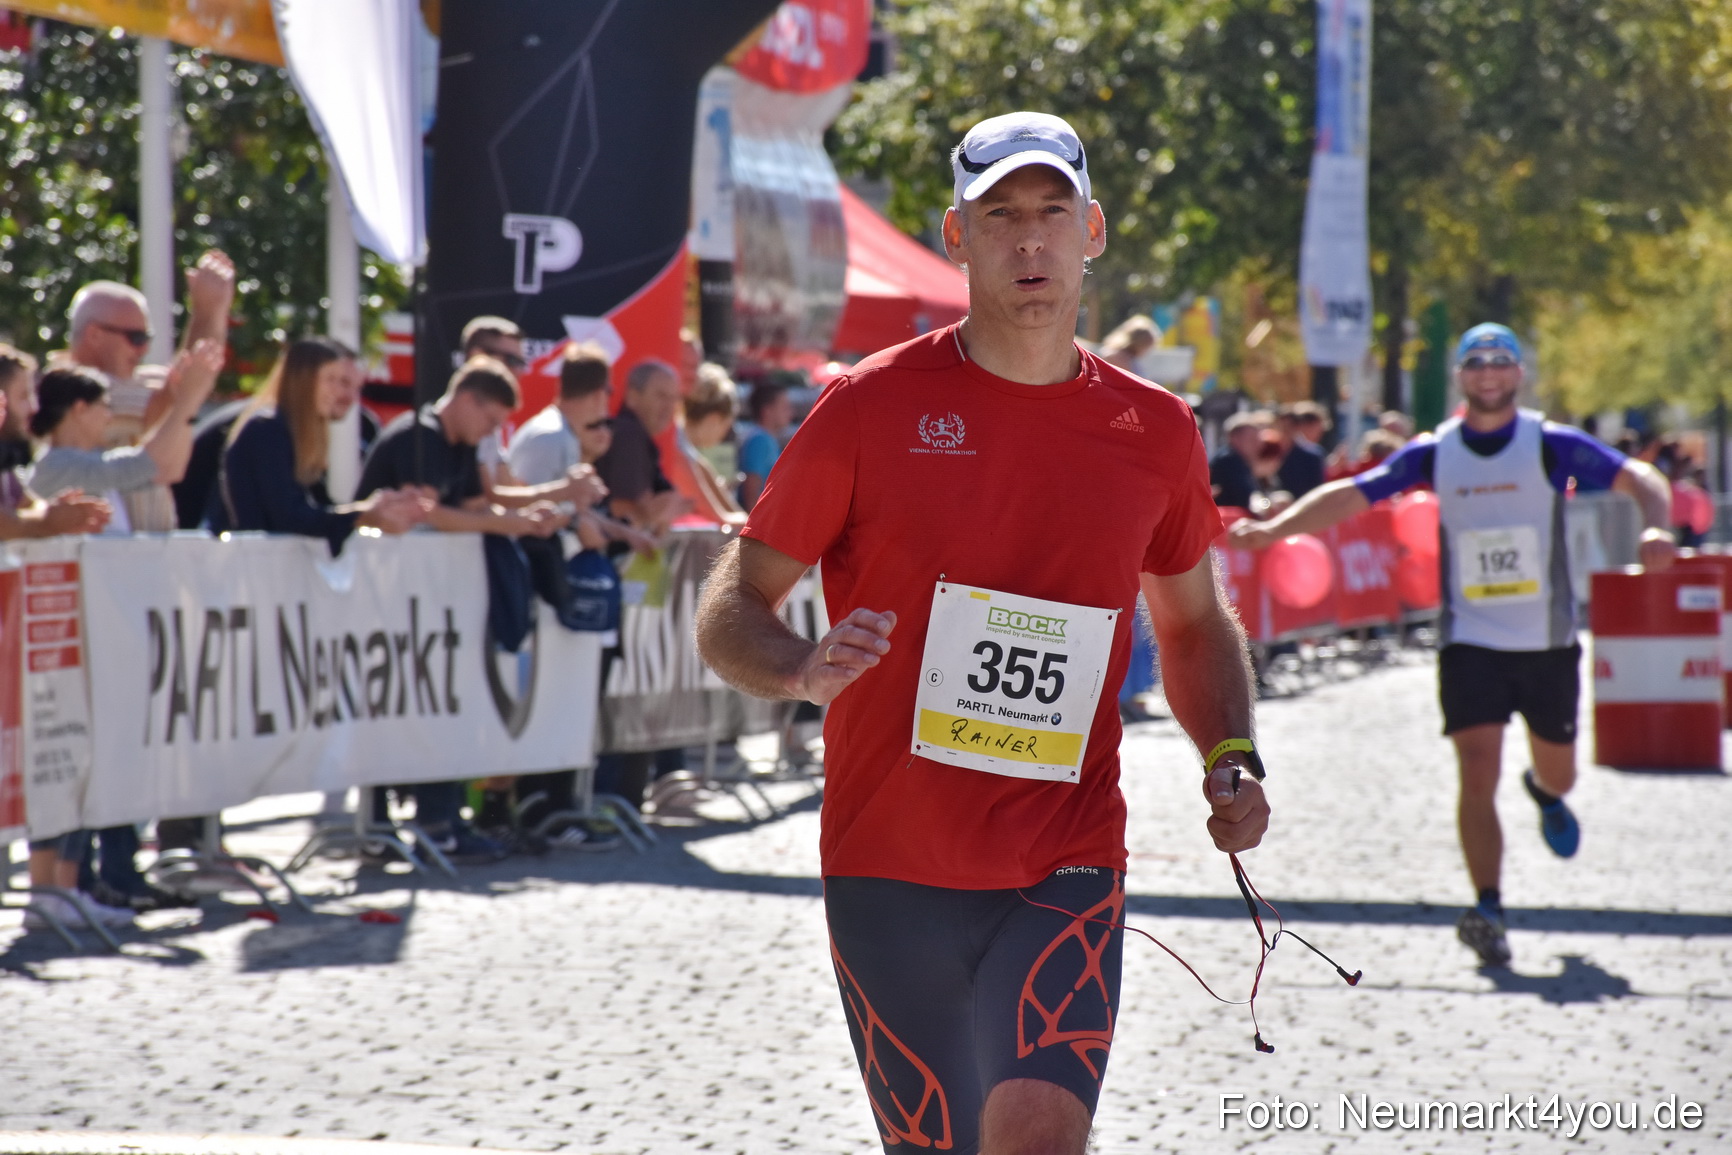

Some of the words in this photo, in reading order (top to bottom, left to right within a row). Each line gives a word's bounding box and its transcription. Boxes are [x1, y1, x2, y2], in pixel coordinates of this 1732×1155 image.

[1109, 419, 1145, 433] adidas
[931, 439, 956, 448] VCM
[1478, 548, 1520, 574] 192
[987, 606, 1068, 637] BOCK
[986, 625, 1011, 635] inspired
[1041, 636, 1066, 644] concepts
[143, 607, 275, 746] PARTL
[967, 640, 1068, 704] 355
[957, 698, 995, 715] PARTL
[998, 706, 1048, 723] Neumarkt
[951, 718, 1038, 758] RAINER
[1056, 865, 1099, 875] adidas
